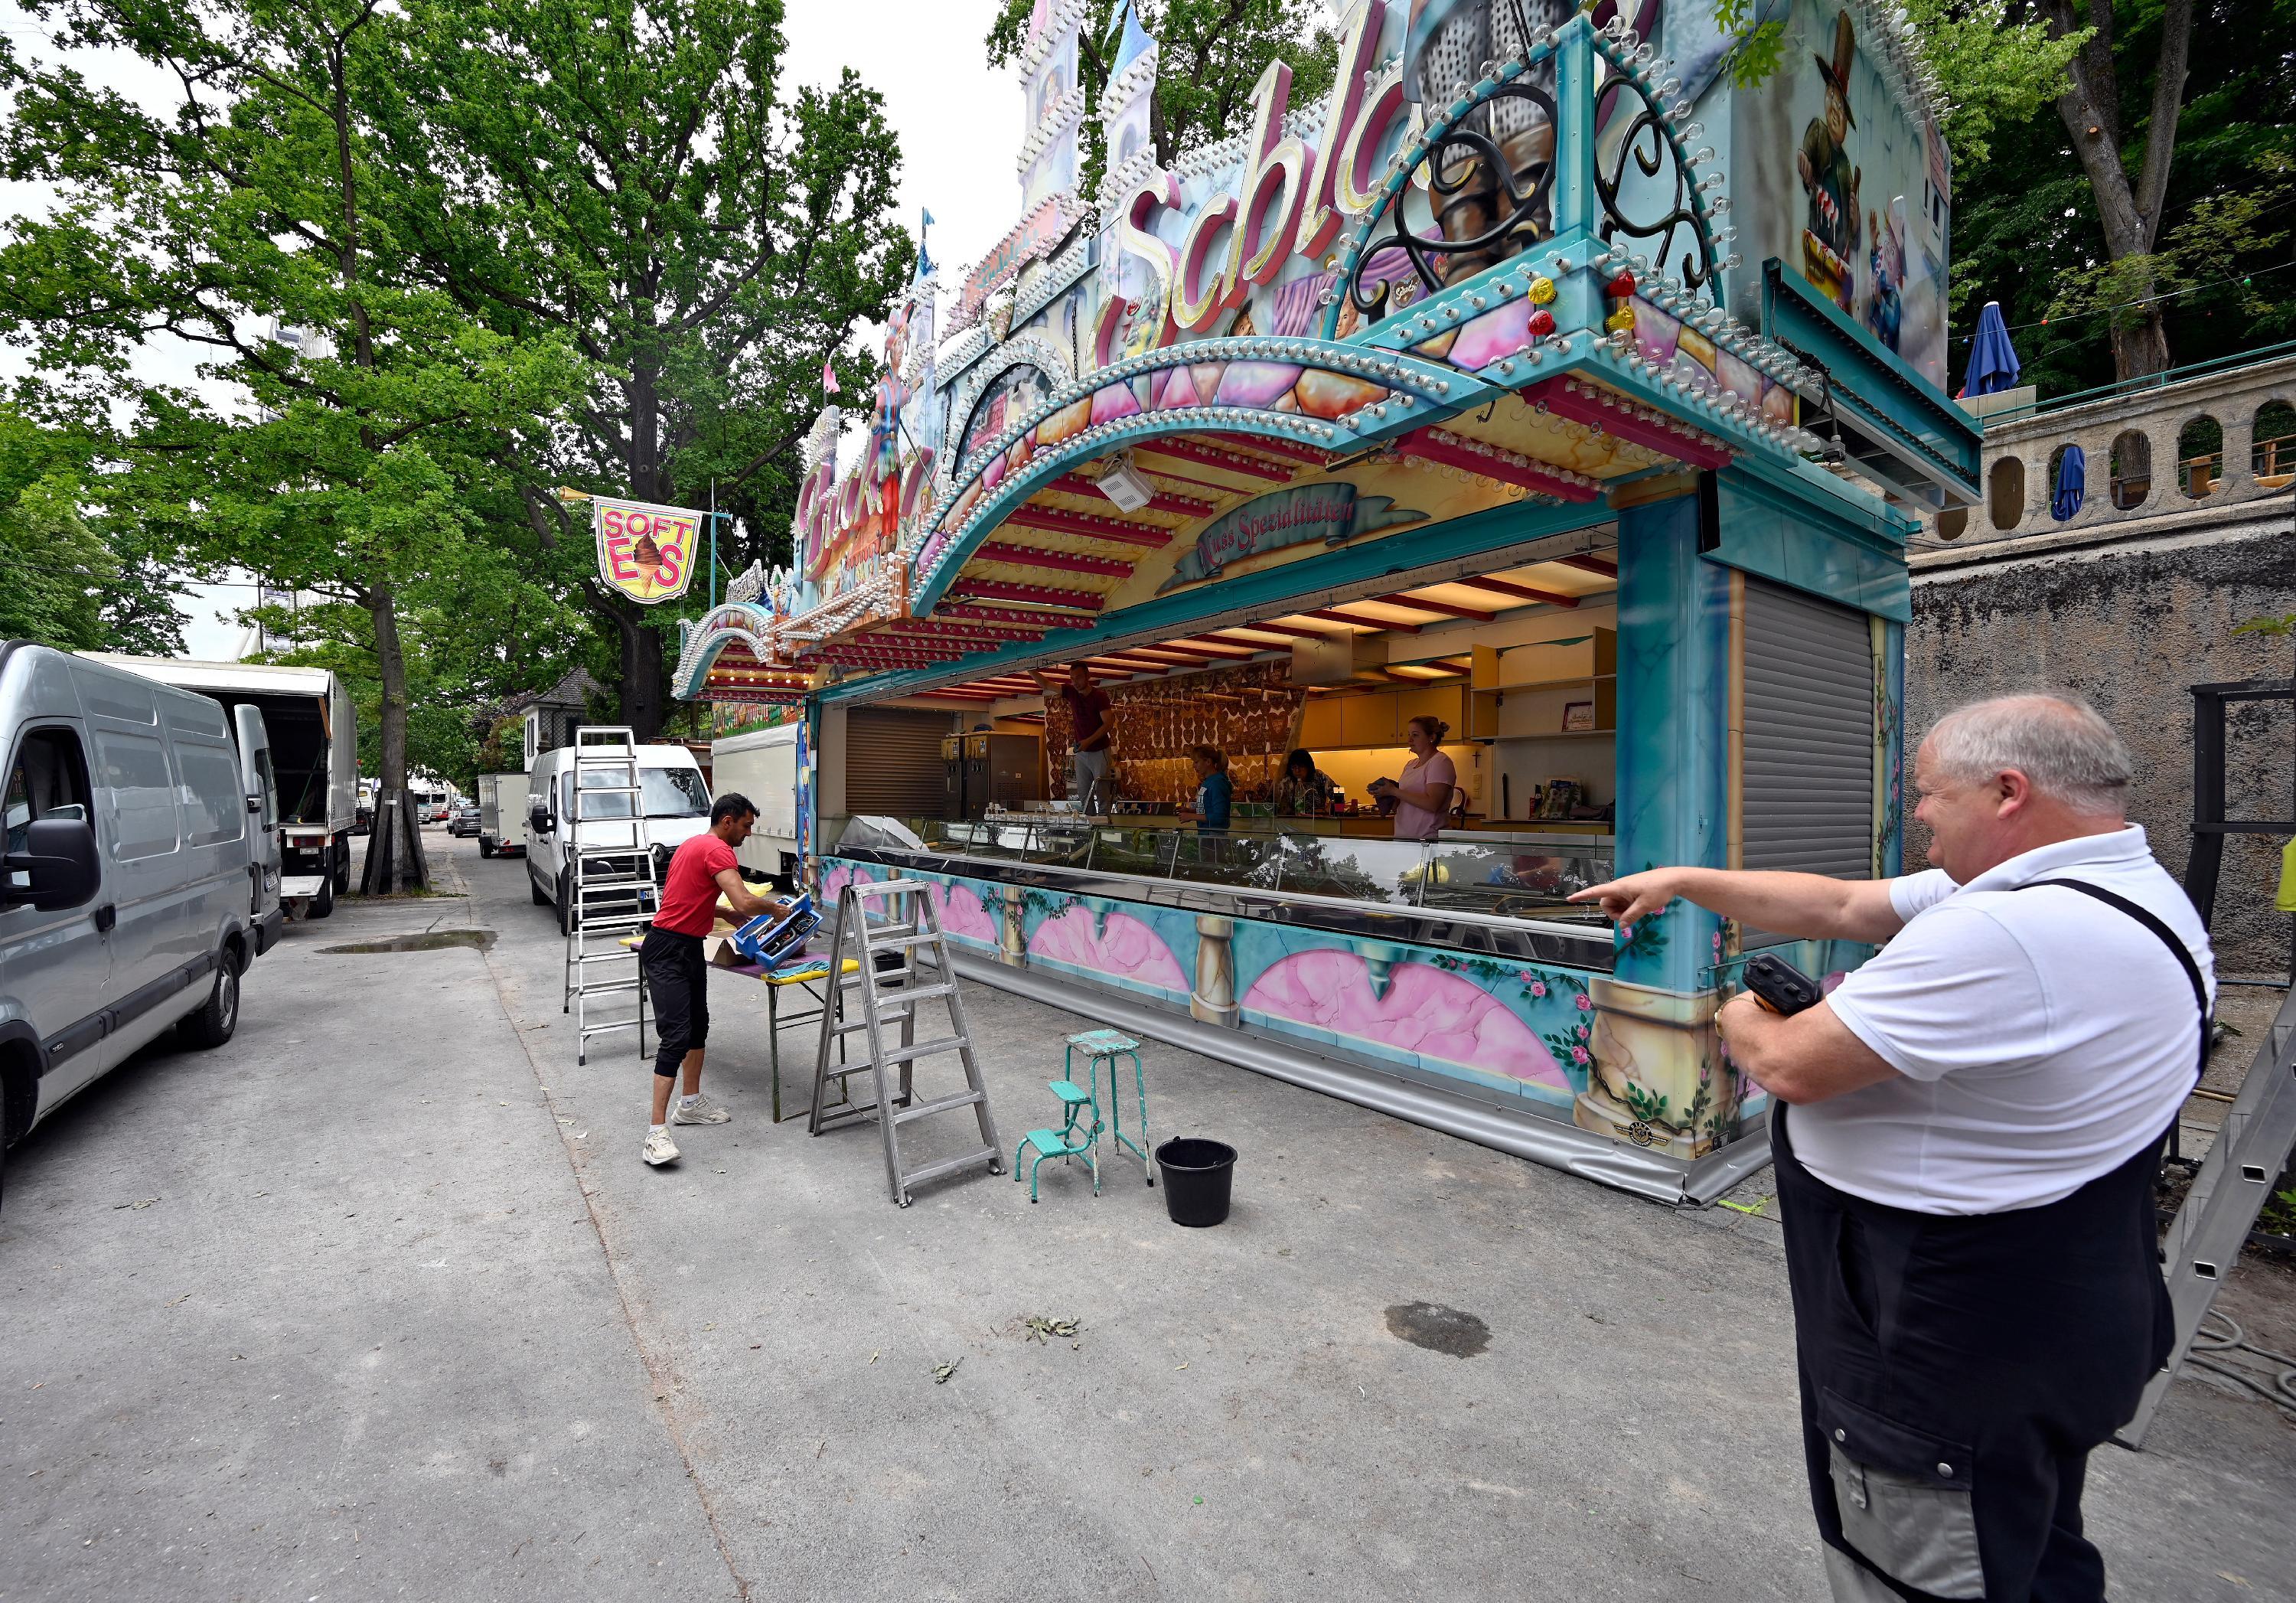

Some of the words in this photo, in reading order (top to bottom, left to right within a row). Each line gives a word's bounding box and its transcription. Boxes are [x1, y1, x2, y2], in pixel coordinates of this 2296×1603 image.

[604, 511, 693, 547] SOFT
[794, 423, 933, 582] Zuckr
[1198, 529, 1235, 567] Nuss
[1238, 496, 1355, 550] Spezialitäten
